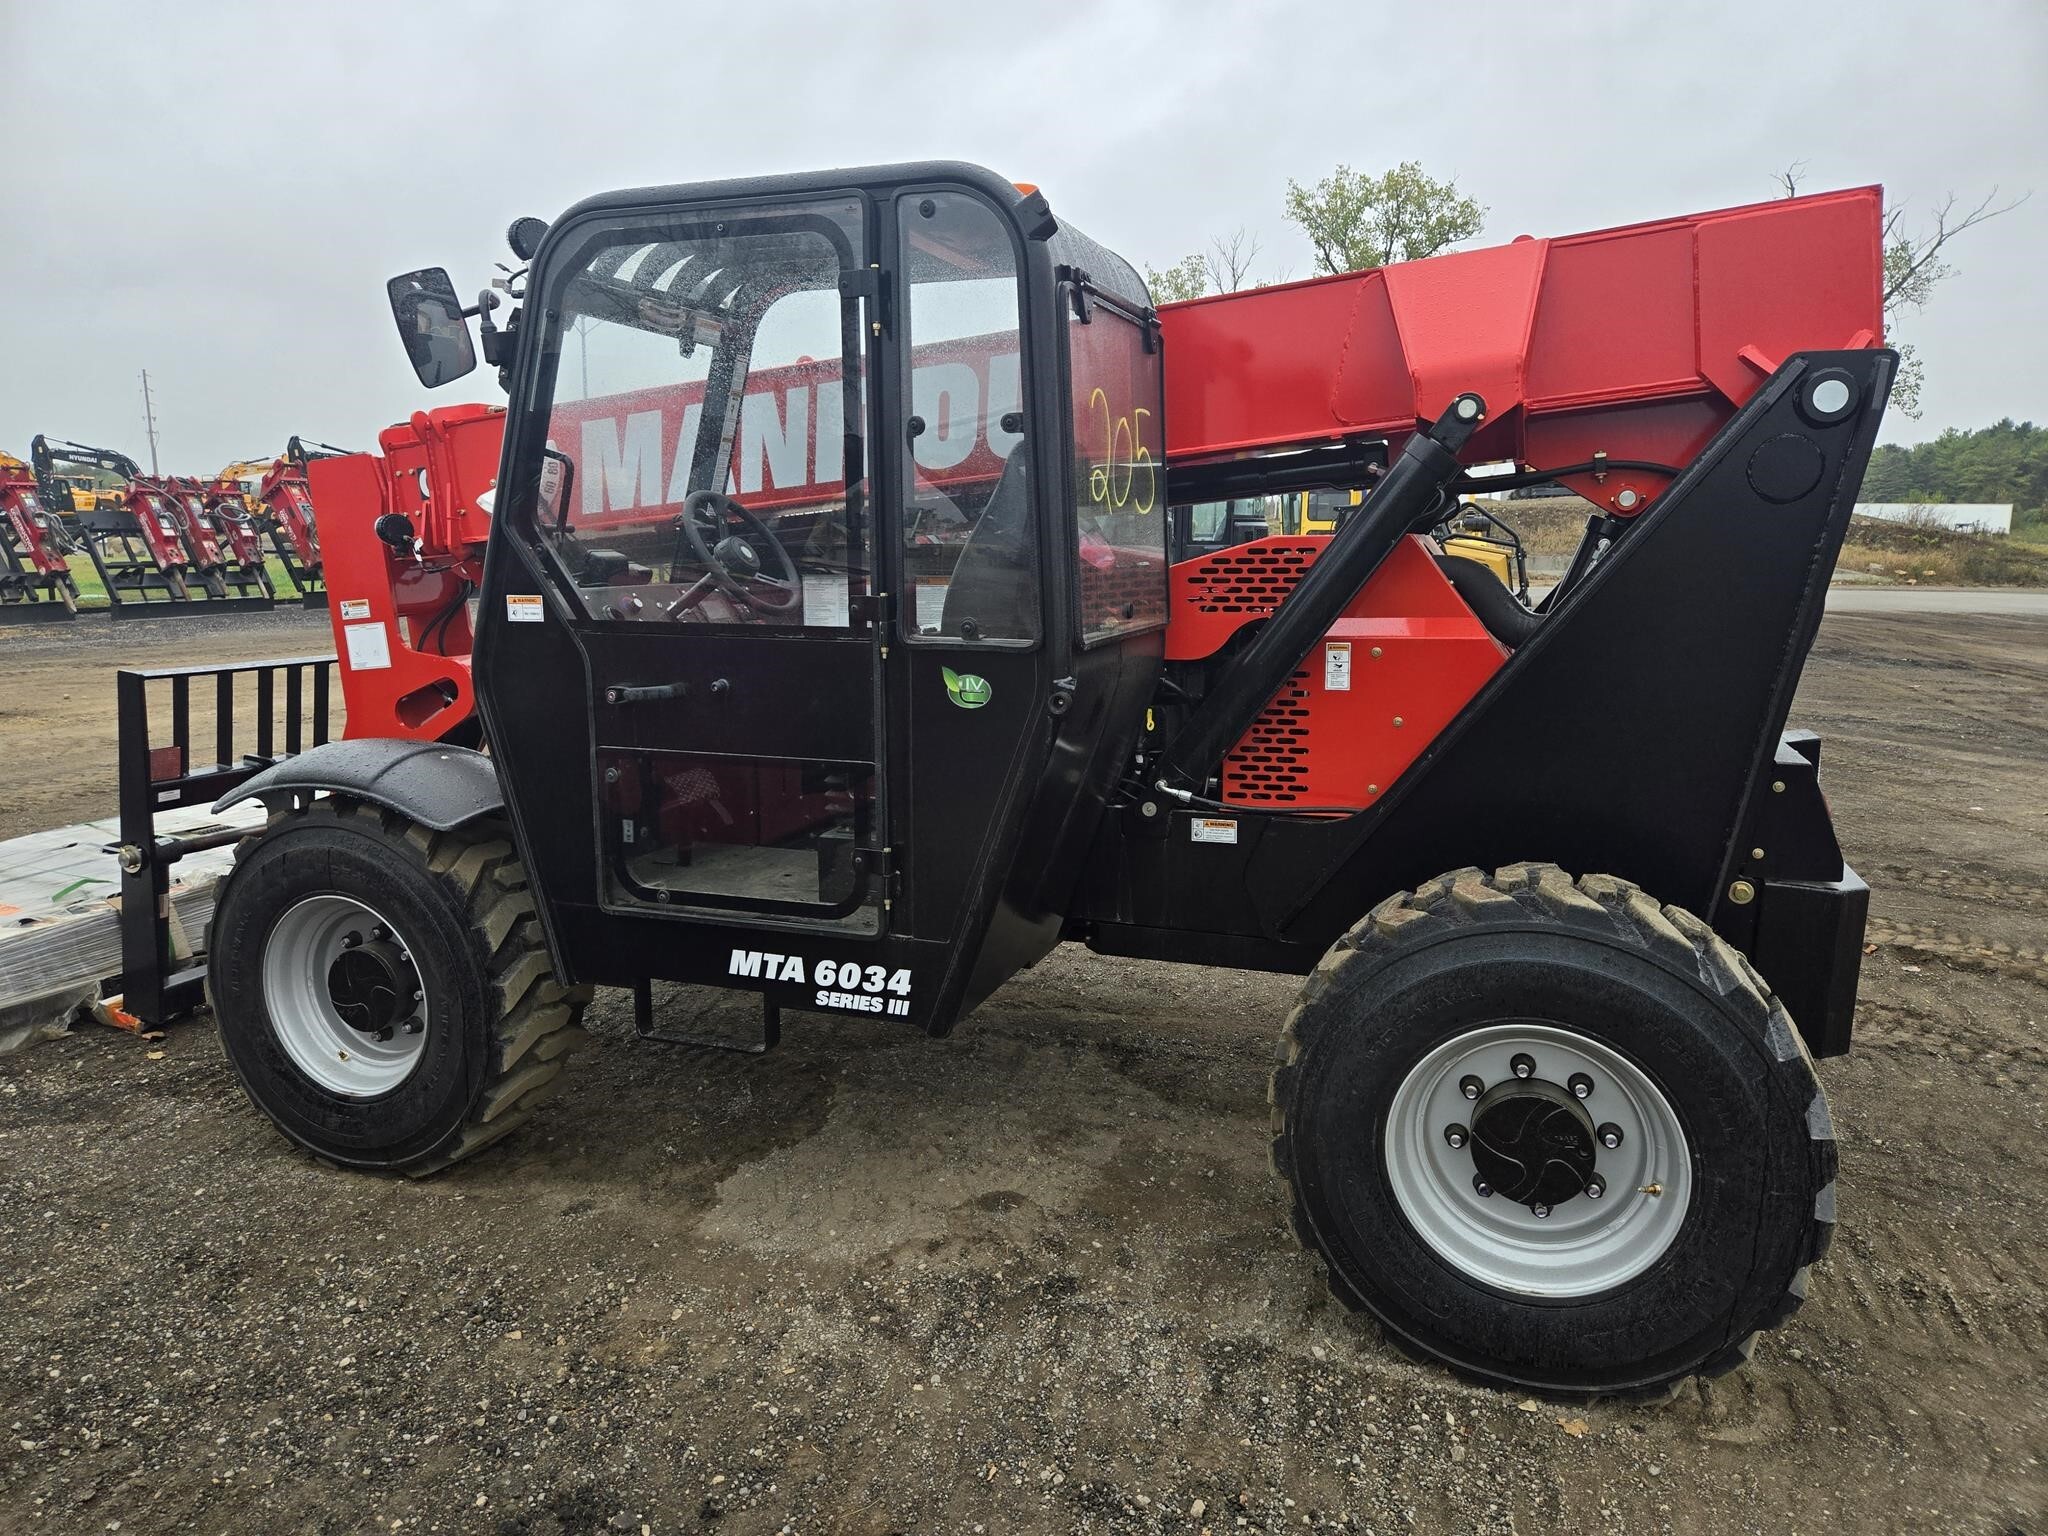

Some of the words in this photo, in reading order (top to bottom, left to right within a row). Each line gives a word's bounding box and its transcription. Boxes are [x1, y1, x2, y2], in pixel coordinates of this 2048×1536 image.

[581, 352, 1022, 515] MANIOU
[1089, 387, 1155, 515] 205
[69, 453, 98, 463] HYUNDAI
[728, 949, 806, 984] MTA
[814, 959, 912, 996] 6034
[815, 990, 884, 1013] SERIES
[886, 998, 911, 1016] III
